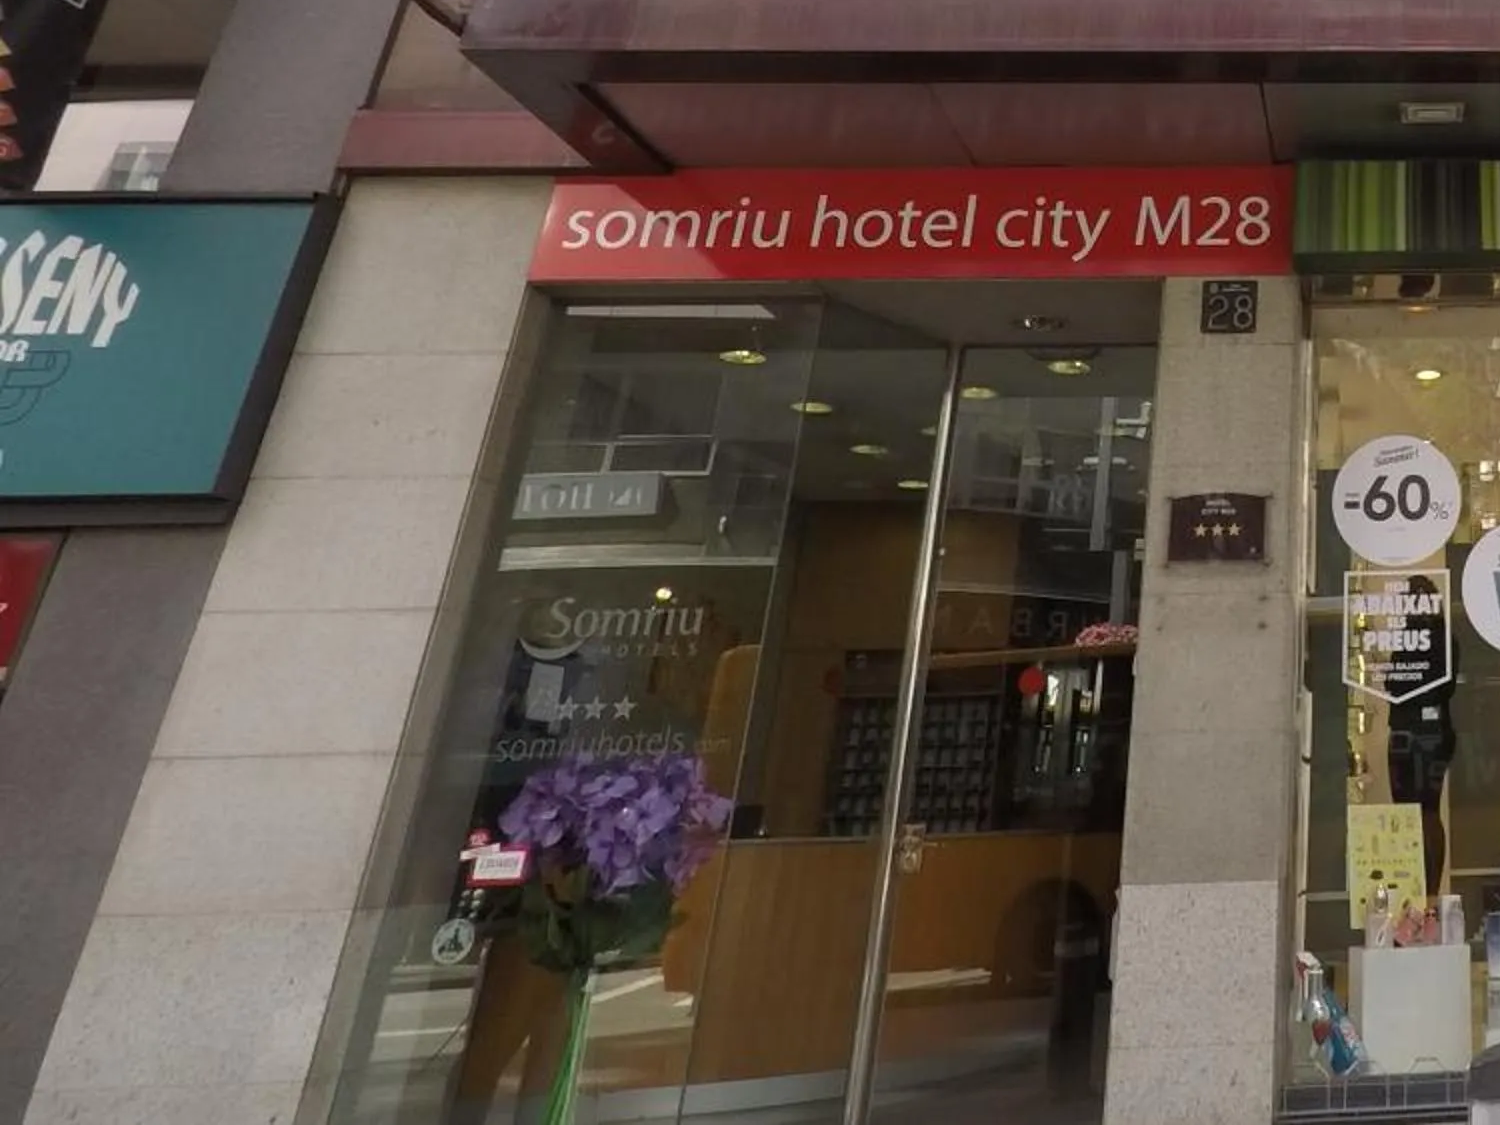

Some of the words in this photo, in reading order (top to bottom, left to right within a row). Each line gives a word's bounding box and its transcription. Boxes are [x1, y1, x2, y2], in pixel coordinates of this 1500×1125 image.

[561, 196, 791, 250] somriu
[810, 194, 975, 250] hotel
[996, 198, 1111, 263] city
[1134, 194, 1271, 247] M28
[0, 230, 140, 348] SENY
[1207, 294, 1254, 329] 28
[543, 596, 704, 639] Somriu
[1362, 629, 1432, 652] PREUS
